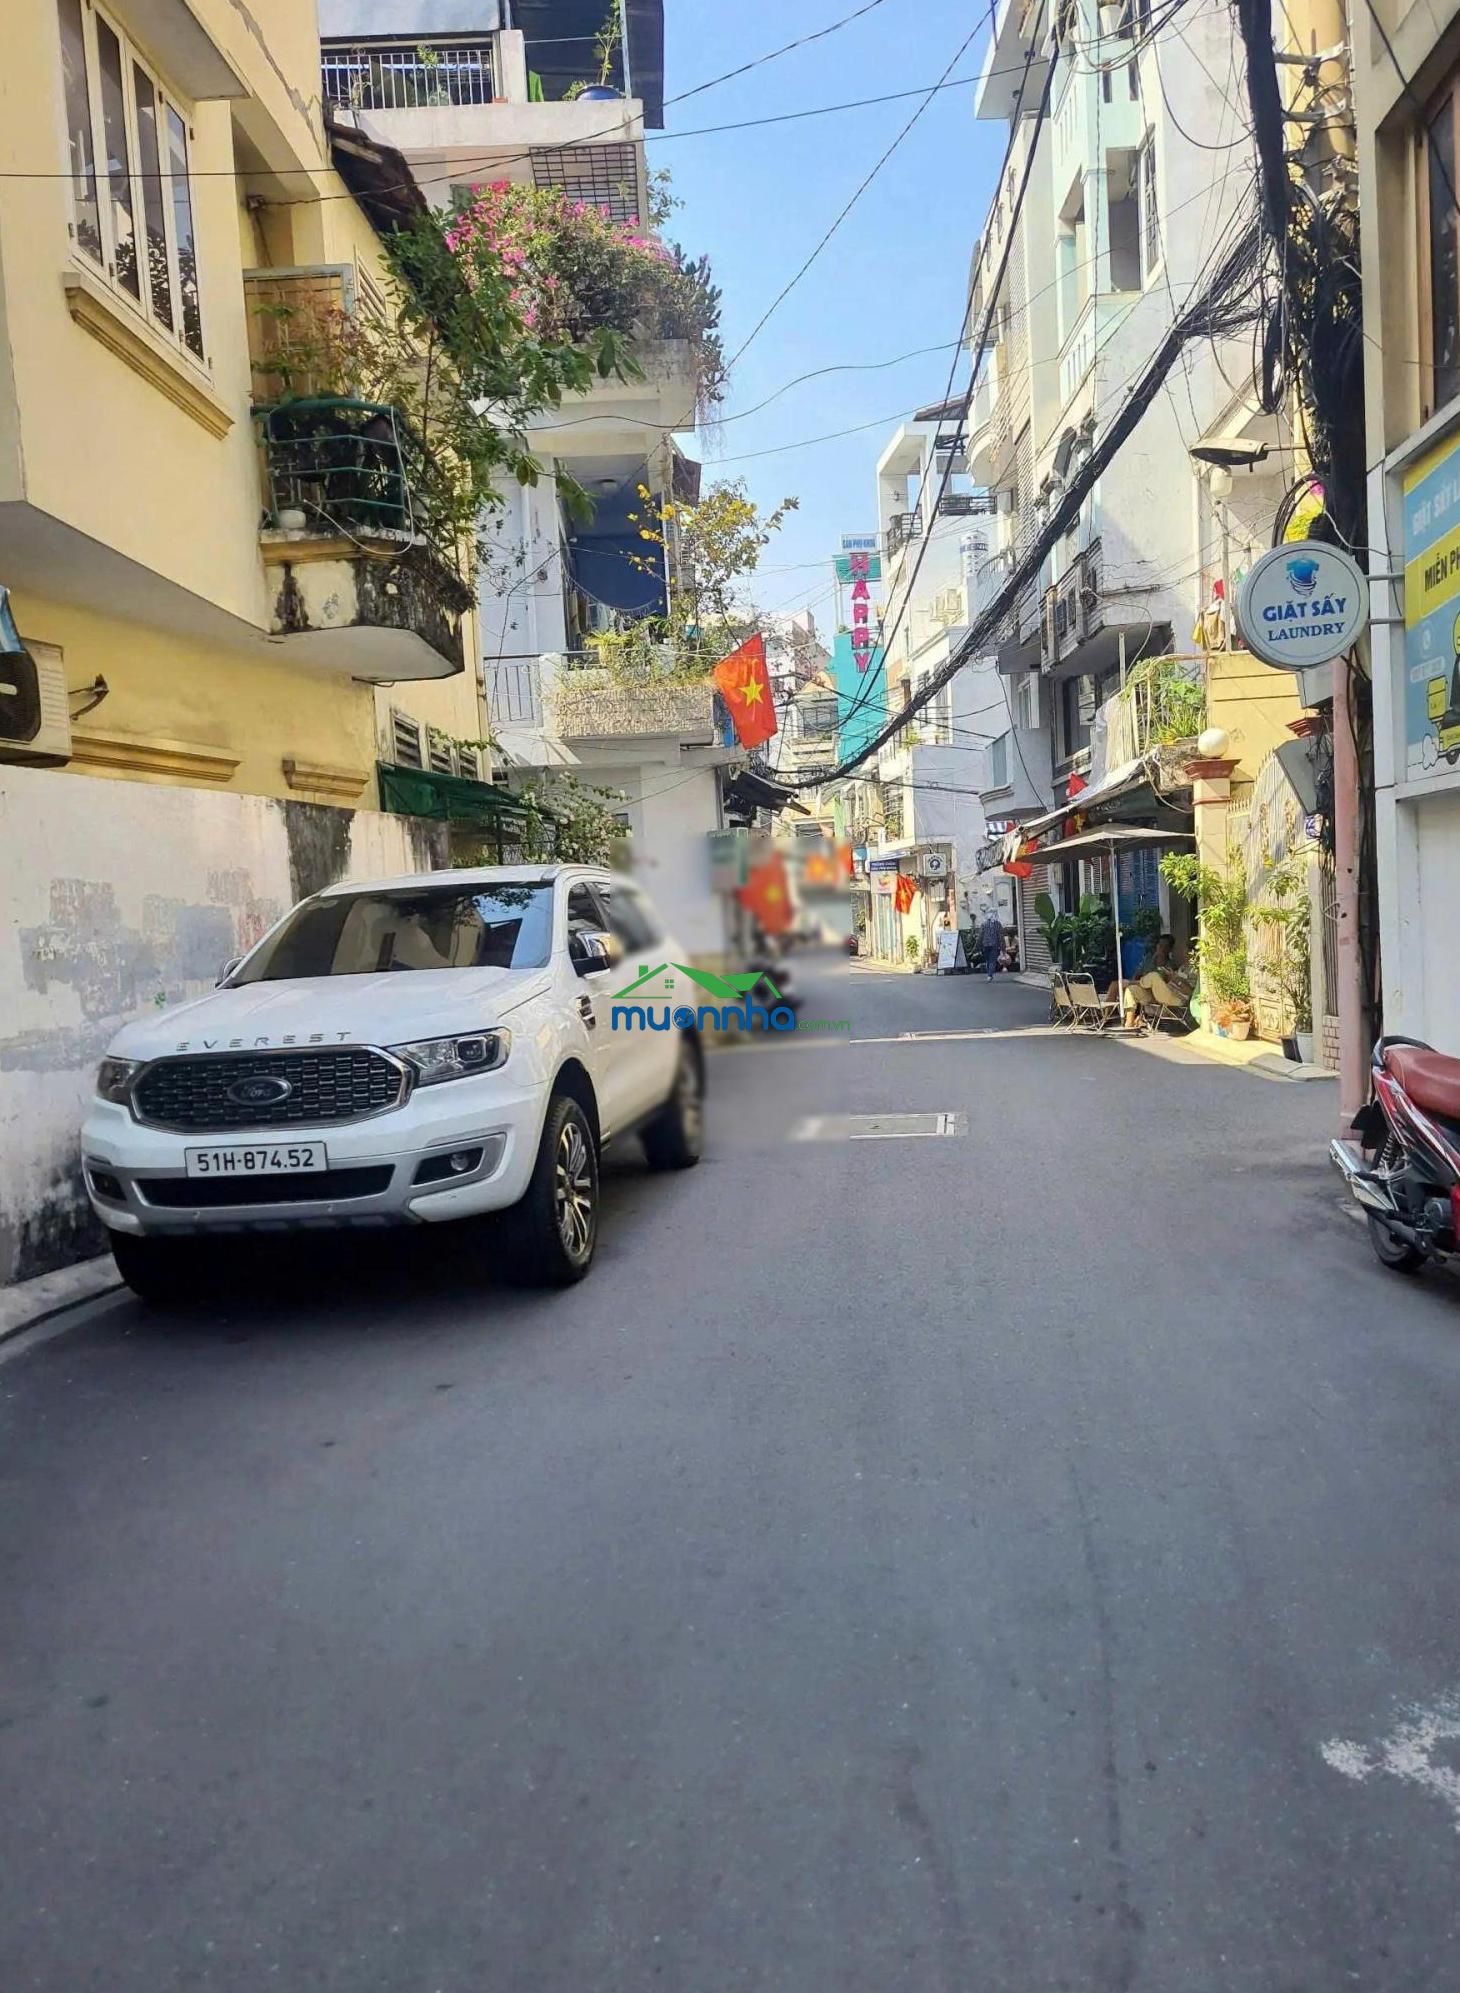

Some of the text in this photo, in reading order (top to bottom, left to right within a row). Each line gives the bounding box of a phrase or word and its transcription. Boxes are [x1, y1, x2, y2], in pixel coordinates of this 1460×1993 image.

[849, 553, 871, 673] HAPPY
[1262, 592, 1346, 622] GIẶT SẤY
[1267, 621, 1345, 641] LAUNDRY
[176, 1031, 351, 1051] EVEREST
[197, 1149, 314, 1172] 51H-874.52
